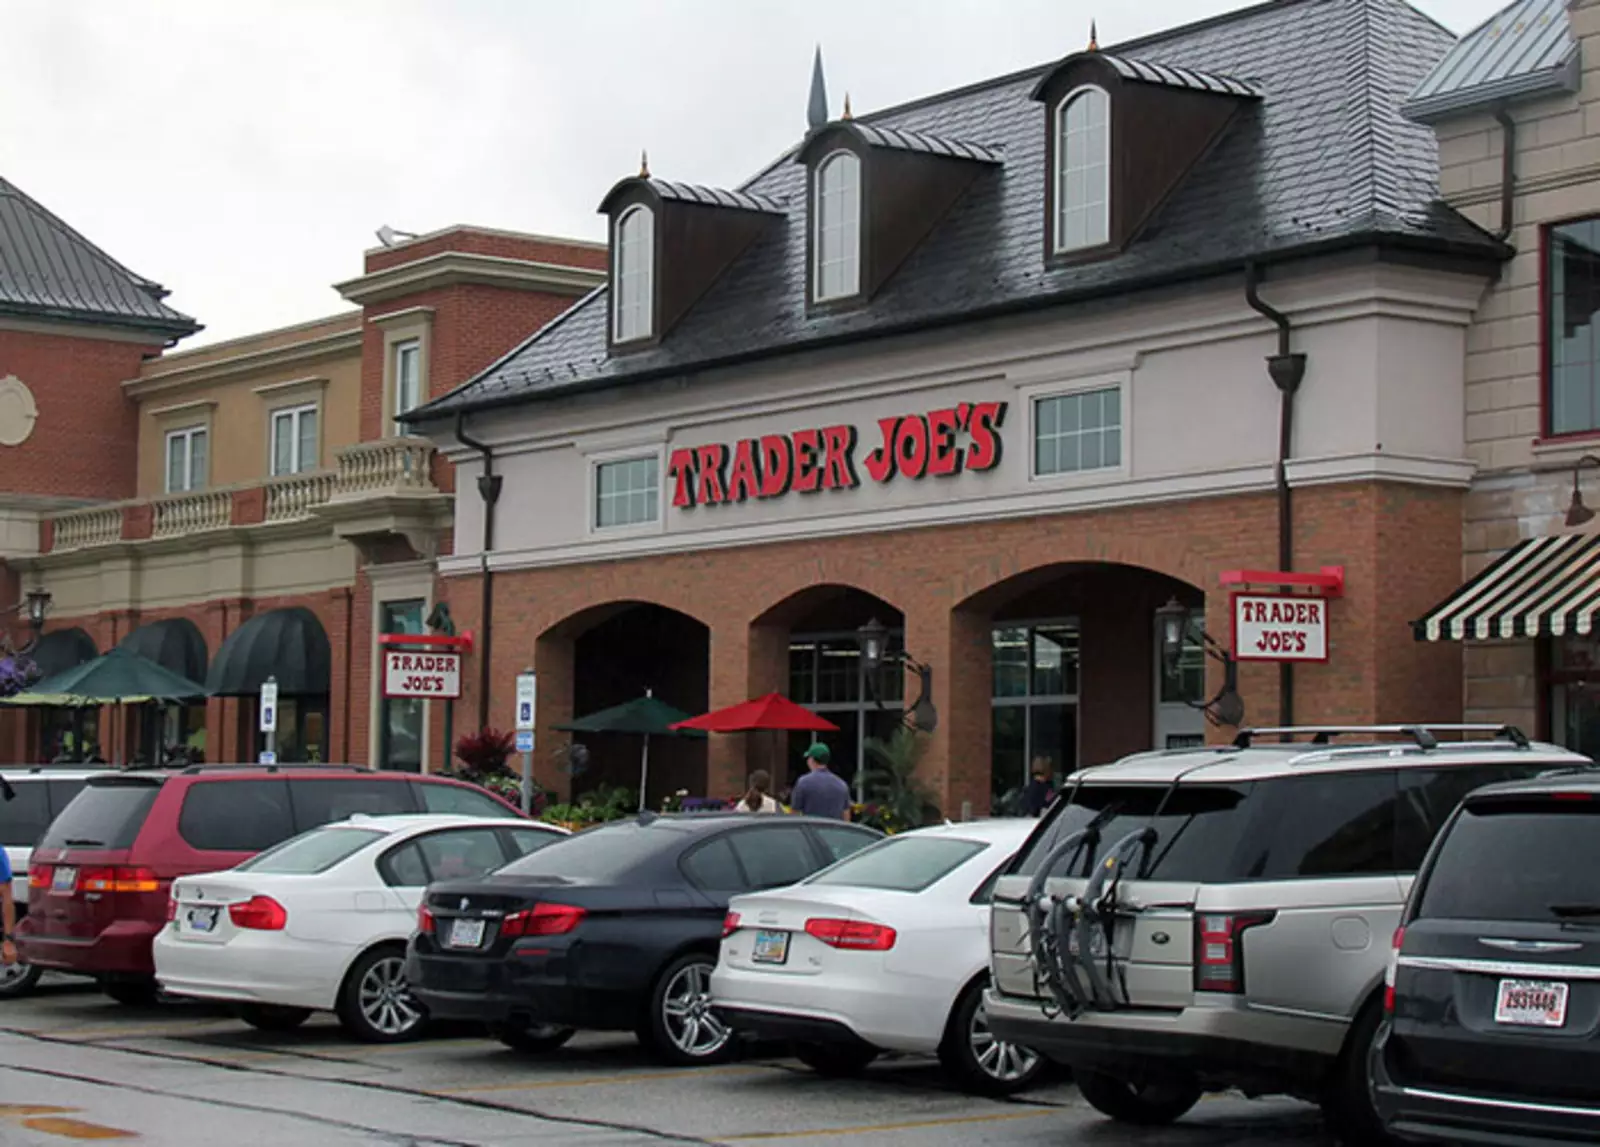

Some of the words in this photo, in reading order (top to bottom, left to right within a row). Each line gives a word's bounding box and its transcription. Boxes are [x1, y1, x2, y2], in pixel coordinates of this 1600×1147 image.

[668, 425, 858, 508] TRADER
[864, 402, 1007, 482] JOE'S
[1242, 601, 1320, 624] TRADER
[1256, 630, 1307, 652] JOE'S
[391, 655, 456, 672] TRADER
[402, 675, 445, 691] JOE'S
